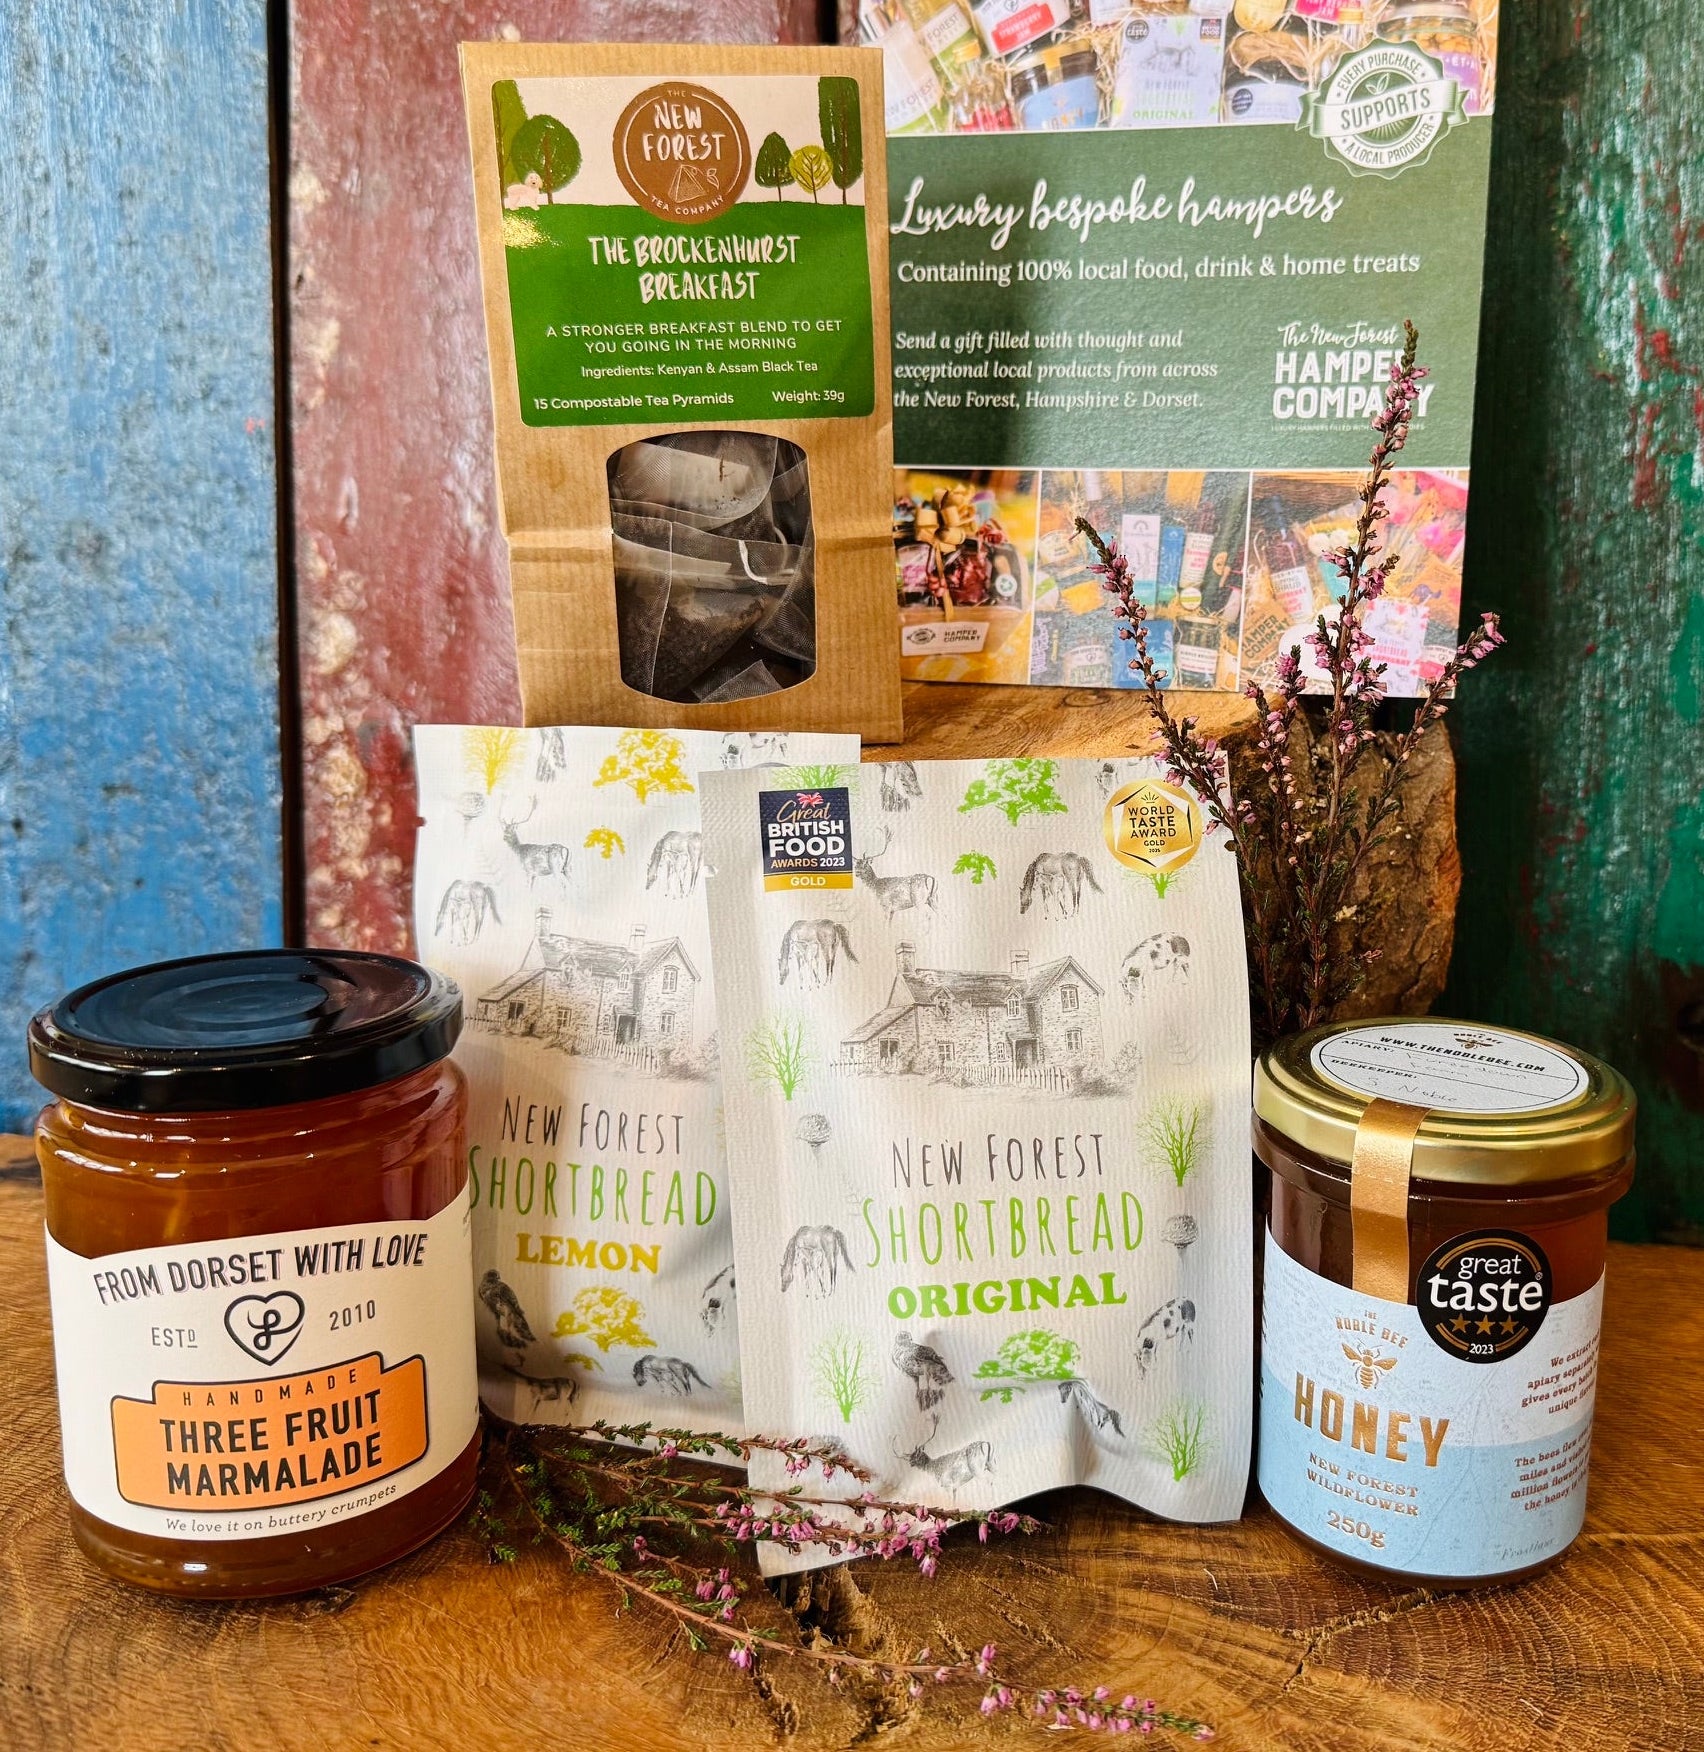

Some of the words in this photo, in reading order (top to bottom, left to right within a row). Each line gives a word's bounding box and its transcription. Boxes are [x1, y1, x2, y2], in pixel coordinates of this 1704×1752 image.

[1337, 59, 1369, 91] EVERY
[1368, 52, 1422, 76] PURCHASE
[667, 89, 687, 97] THE
[654, 100, 702, 129] NEW
[1340, 87, 1431, 131] SUPPORTS
[642, 132, 726, 162] FOREST
[1344, 143, 1354, 154] A
[1353, 147, 1385, 165] LOCAL
[1388, 122, 1434, 165] PRODUCER
[651, 194, 670, 212] TEA
[675, 194, 725, 216] COMPANY
[890, 175, 1024, 251] Luxury
[1029, 174, 1173, 244] bespoke
[1178, 175, 1344, 239] hampers
[588, 236, 631, 266] THE
[636, 234, 801, 267] BROCKENHURST
[898, 259, 1012, 288] Containing
[1017, 258, 1073, 281] 100%
[1079, 257, 1128, 280] local
[1134, 255, 1189, 281] food,
[1195, 255, 1253, 279] drink
[1259, 255, 1277, 277] &
[1282, 252, 1346, 276] home
[1352, 252, 1421, 274] treats
[639, 271, 760, 304] BREAKFAST
[546, 326, 558, 338] A
[562, 324, 645, 337] STRONGER
[649, 321, 735, 336] BREAKFAST
[740, 320, 787, 333] BLEND
[792, 320, 811, 332] TO
[816, 319, 842, 332] GET
[895, 330, 937, 349] Send
[940, 338, 951, 349] a
[954, 330, 984, 354] gift
[984, 329, 1030, 354] filled
[1034, 330, 1073, 349] with
[1078, 329, 1145, 353] thought
[1149, 329, 1184, 348] and
[1278, 321, 1309, 347] The
[1310, 322, 1344, 346] New
[1343, 320, 1399, 348] Forest
[584, 341, 616, 354] YOU
[622, 340, 670, 353] GOING
[675, 339, 690, 351] IN
[695, 338, 723, 350] THE
[729, 337, 797, 350] MORNING
[581, 364, 654, 379] Ingredients:
[657, 363, 703, 377] Kenyan
[706, 362, 716, 374] &
[718, 362, 759, 373] Assam
[762, 360, 794, 372] Black
[796, 360, 818, 372] Tea
[894, 359, 989, 383] exceptional
[993, 359, 1033, 378] local
[1036, 359, 1112, 384] products
[1112, 360, 1157, 383] from
[1162, 363, 1218, 378] across
[534, 398, 548, 410] 15
[551, 395, 643, 411] Compostable
[645, 394, 669, 407] Tea
[672, 392, 735, 408] Pyramids
[772, 390, 821, 404] Weight:
[823, 390, 845, 403] 39g
[893, 390, 920, 408] the
[923, 390, 962, 408] New
[965, 389, 1021, 411] Forest,
[1025, 390, 1119, 413] Hampshire
[1123, 391, 1138, 407] &
[1142, 390, 1204, 408] Dorset.
[1272, 382, 1435, 419] COMPAY
[776, 800, 832, 825] Great
[1127, 805, 1175, 816] WORLD
[1129, 816, 1175, 829] TASTE
[768, 820, 844, 838] BRITISH
[1130, 828, 1177, 839] AWARD
[769, 836, 845, 858] FOOD
[1143, 839, 1166, 847] GOLD
[771, 858, 818, 869] AWARDS
[820, 857, 846, 867] 2023
[790, 876, 826, 887] GOLD
[1380, 1036, 1546, 1072] WWW.THENOBLEBEE.COM
[501, 1095, 562, 1146] NEW
[579, 1102, 684, 1155] FOREST
[892, 1137, 963, 1189] NEW
[987, 1133, 1103, 1182] FOREST
[468, 1144, 717, 1226] SHORTBREAD
[862, 1191, 1144, 1268] SHORTBREAD
[515, 1232, 662, 1275] LEMON
[1457, 1254, 1522, 1280] great
[93, 1264, 164, 1305] FROM
[167, 1249, 285, 1293] DORSET
[294, 1238, 366, 1277] WITH
[372, 1233, 428, 1268] LOVE
[887, 1271, 1128, 1320] ORIGINAL
[1427, 1272, 1544, 1313] taste
[329, 1299, 377, 1331] 2010
[1364, 1309, 1378, 1320] THE
[1335, 1316, 1377, 1336] NOBLE
[1381, 1327, 1409, 1349] BEE
[1469, 1343, 1494, 1355] 2023
[1550, 1356, 1564, 1368] We
[183, 1368, 357, 1406] HANDMADE
[1521, 1392, 1550, 1408] gives
[1552, 1381, 1577, 1398] every
[1527, 1373, 1561, 1390] apiary
[1548, 1396, 1578, 1414] unique
[160, 1417, 270, 1454] THREE
[285, 1389, 382, 1448] FRUIT
[1294, 1370, 1451, 1468] HONEY
[166, 1432, 383, 1497] MARMALADE
[1514, 1457, 1536, 1467] The
[1538, 1448, 1560, 1462] bees
[1519, 1468, 1549, 1482] miles
[1550, 1458, 1567, 1472] and
[1309, 1452, 1340, 1476] NEW
[1346, 1469, 1419, 1498] FOREST
[1307, 1467, 1419, 1517] WILDFLOWER
[1511, 1482, 1549, 1499] million
[1524, 1499, 1542, 1511] the
[1544, 1486, 1570, 1504] honey
[166, 1518, 187, 1532] We
[191, 1519, 222, 1533] love
[227, 1518, 239, 1532] it
[244, 1521, 263, 1530] on
[268, 1508, 327, 1528] buttery
[331, 1483, 397, 1516] crumpets
[1327, 1509, 1386, 1548] 250g
